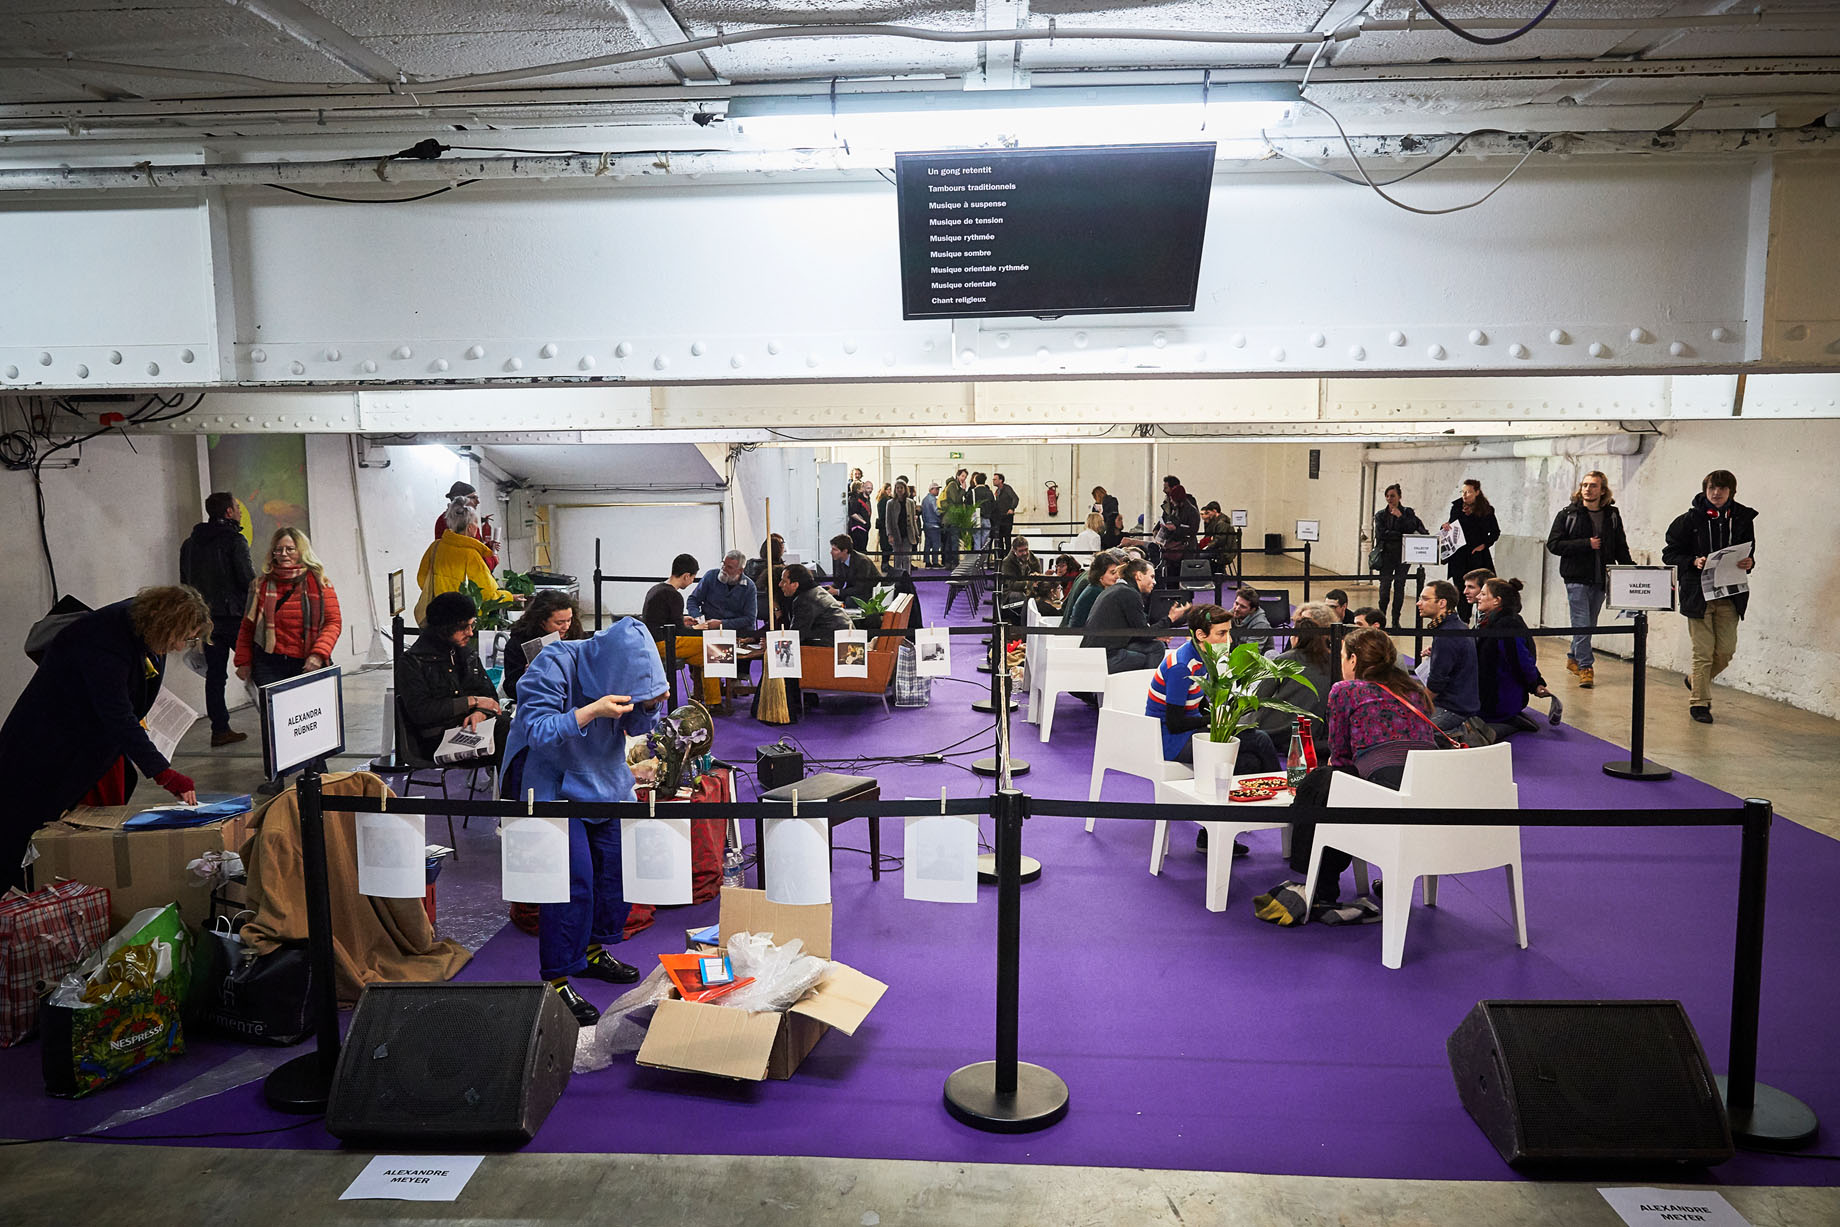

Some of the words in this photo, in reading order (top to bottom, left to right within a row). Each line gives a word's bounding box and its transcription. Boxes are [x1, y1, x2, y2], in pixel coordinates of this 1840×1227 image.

[928, 168, 939, 176] Un
[941, 168, 961, 177] gong
[963, 167, 992, 175] retentit
[928, 185, 966, 193] Tambours
[968, 183, 1017, 192] traditionnels
[929, 202, 962, 210] Musique
[964, 201, 969, 209] à
[930, 219, 962, 227] Musique
[975, 217, 1004, 225] tension
[930, 235, 962, 243] Musique
[964, 234, 996, 243] rythmée
[931, 251, 963, 259] Musique
[931, 267, 963, 275] Musique
[964, 265, 997, 273] orientale
[999, 264, 1030, 273] rythmée
[932, 282, 963, 290] Musique
[956, 297, 987, 305] religieux
[287, 707, 322, 727] ALEXANDRA
[293, 721, 318, 737] RÜBNER
[111, 1024, 164, 1050] NESPRESSO
[1640, 1205, 1713, 1214] ALEXANDRE
[1661, 1214, 1707, 1222] MEYER
